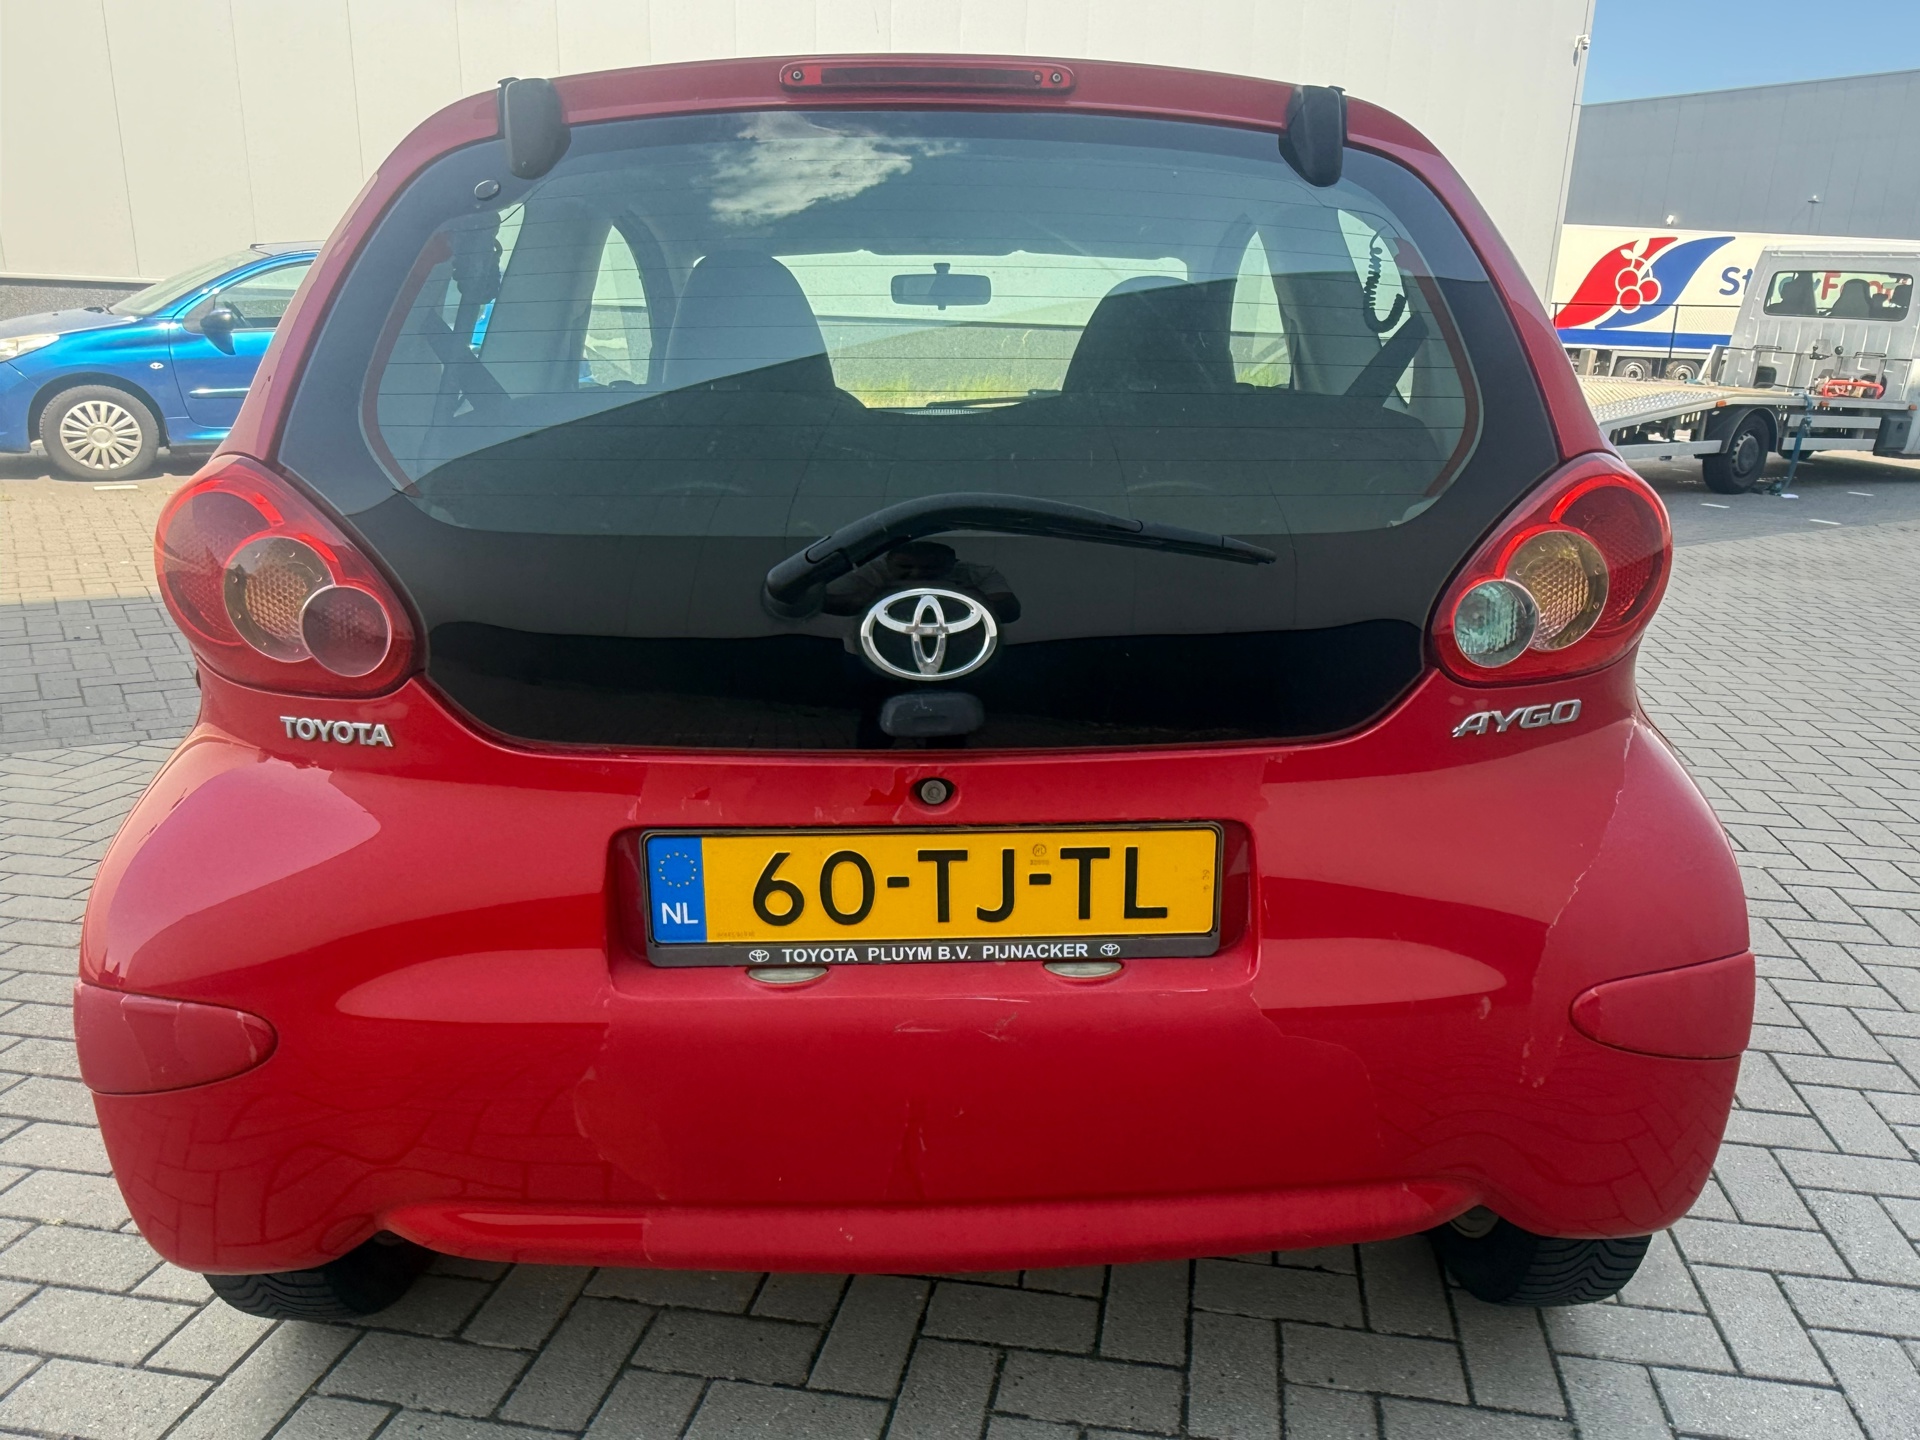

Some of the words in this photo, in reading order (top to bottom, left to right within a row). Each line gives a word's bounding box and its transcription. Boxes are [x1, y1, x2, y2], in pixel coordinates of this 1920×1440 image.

[279, 715, 394, 747] TOYOTA
[1452, 699, 1582, 738] AYGO
[752, 847, 1169, 926] 60-TJ-TL
[661, 902, 699, 925] NL
[781, 948, 858, 963] TOYOTA
[867, 946, 932, 961] PLUYM
[938, 945, 972, 960] B.V.
[982, 943, 1088, 959] PIJNACKER
